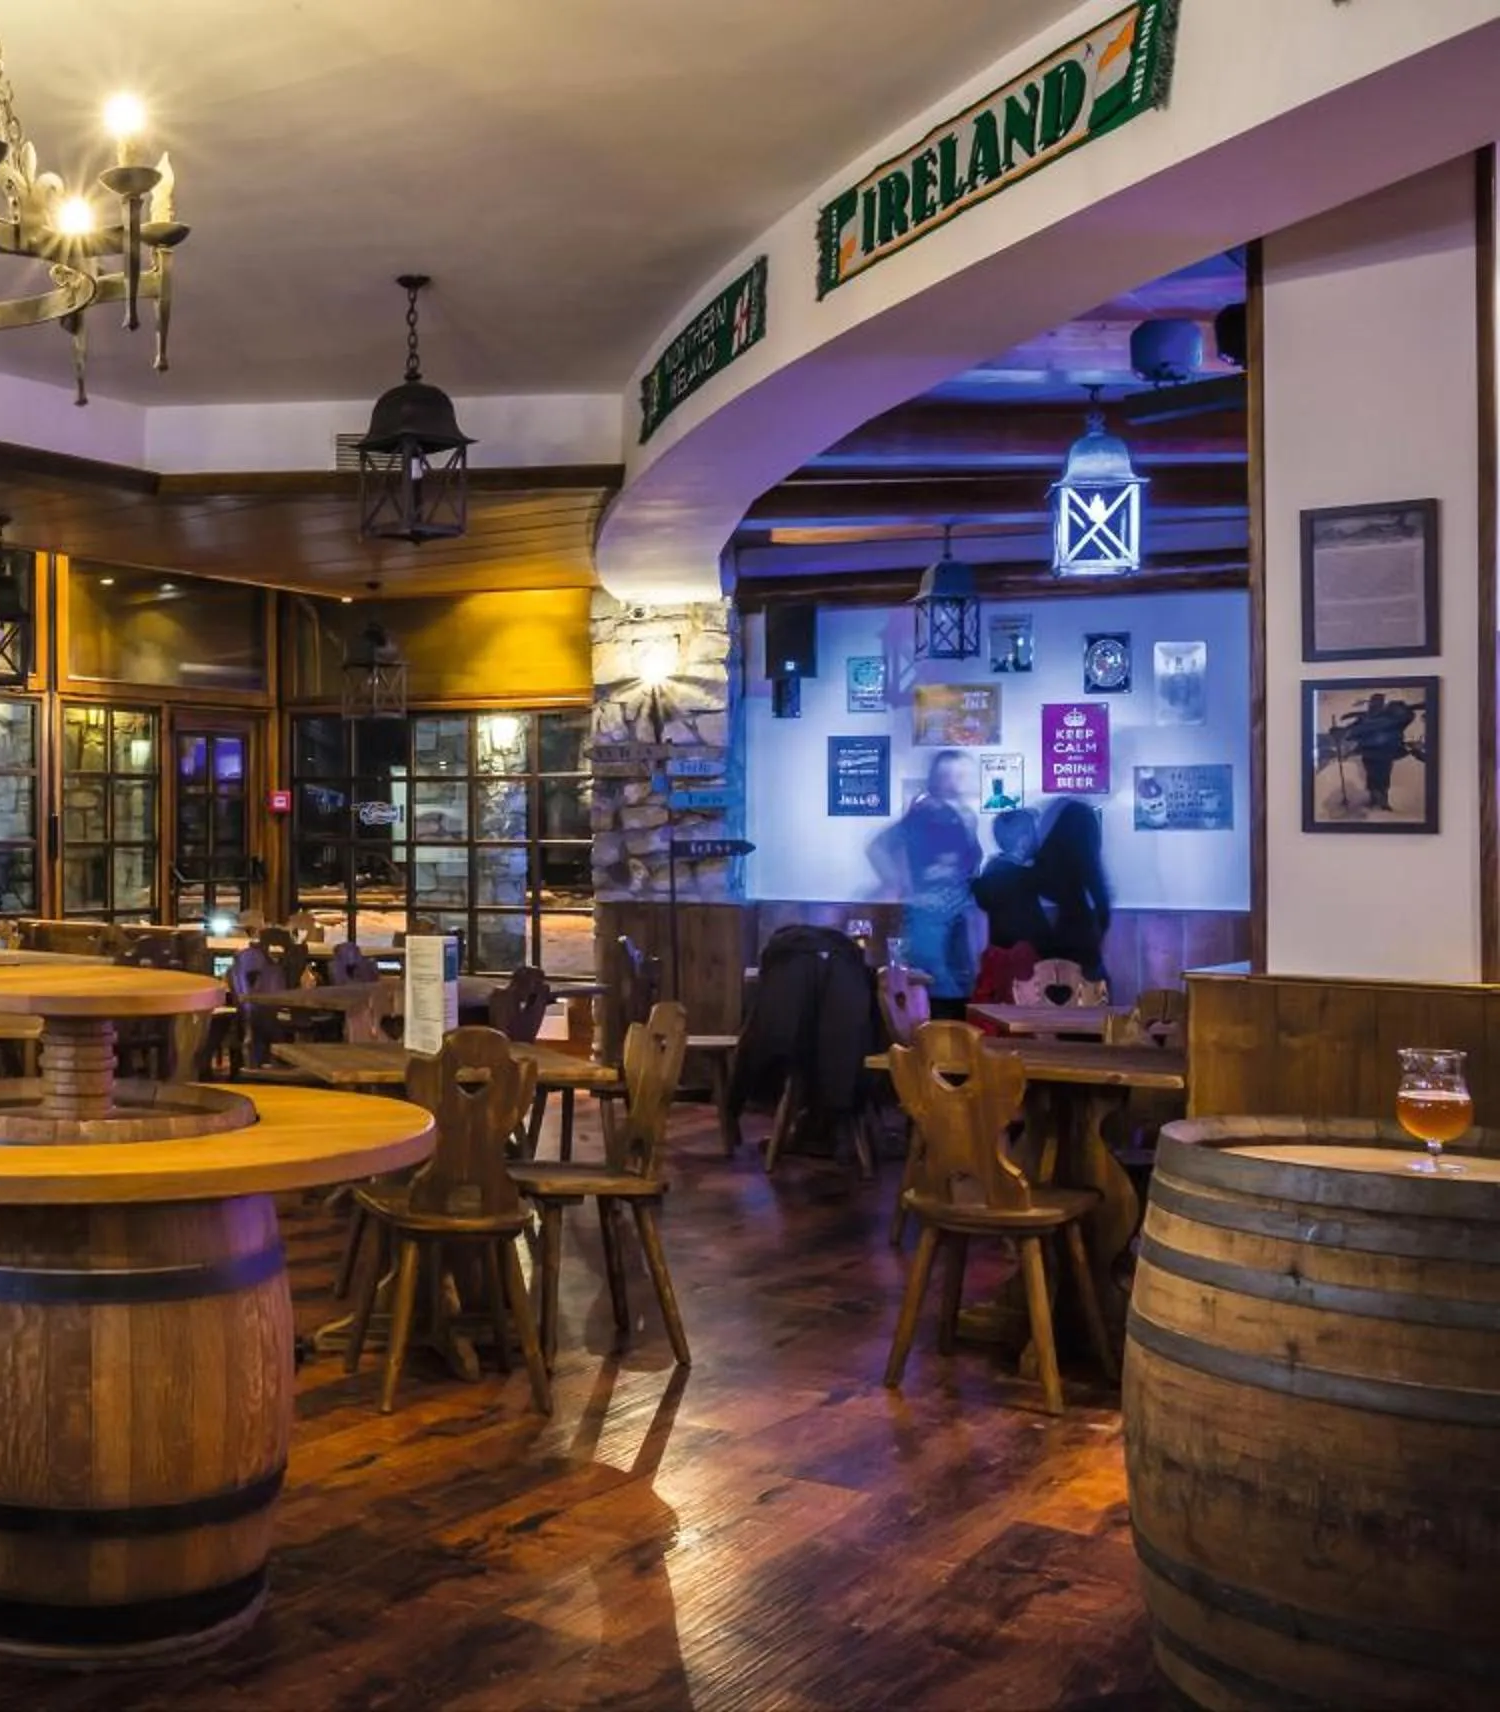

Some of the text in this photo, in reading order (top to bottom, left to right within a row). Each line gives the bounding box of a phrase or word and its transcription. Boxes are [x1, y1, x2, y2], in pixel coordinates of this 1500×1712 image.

[861, 59, 1087, 256] IRELAND
[1055, 728, 1095, 740] KEEP
[1053, 742, 1097, 753] CALM
[1053, 763, 1098, 775] DRINK
[1057, 777, 1094, 788] BEER
